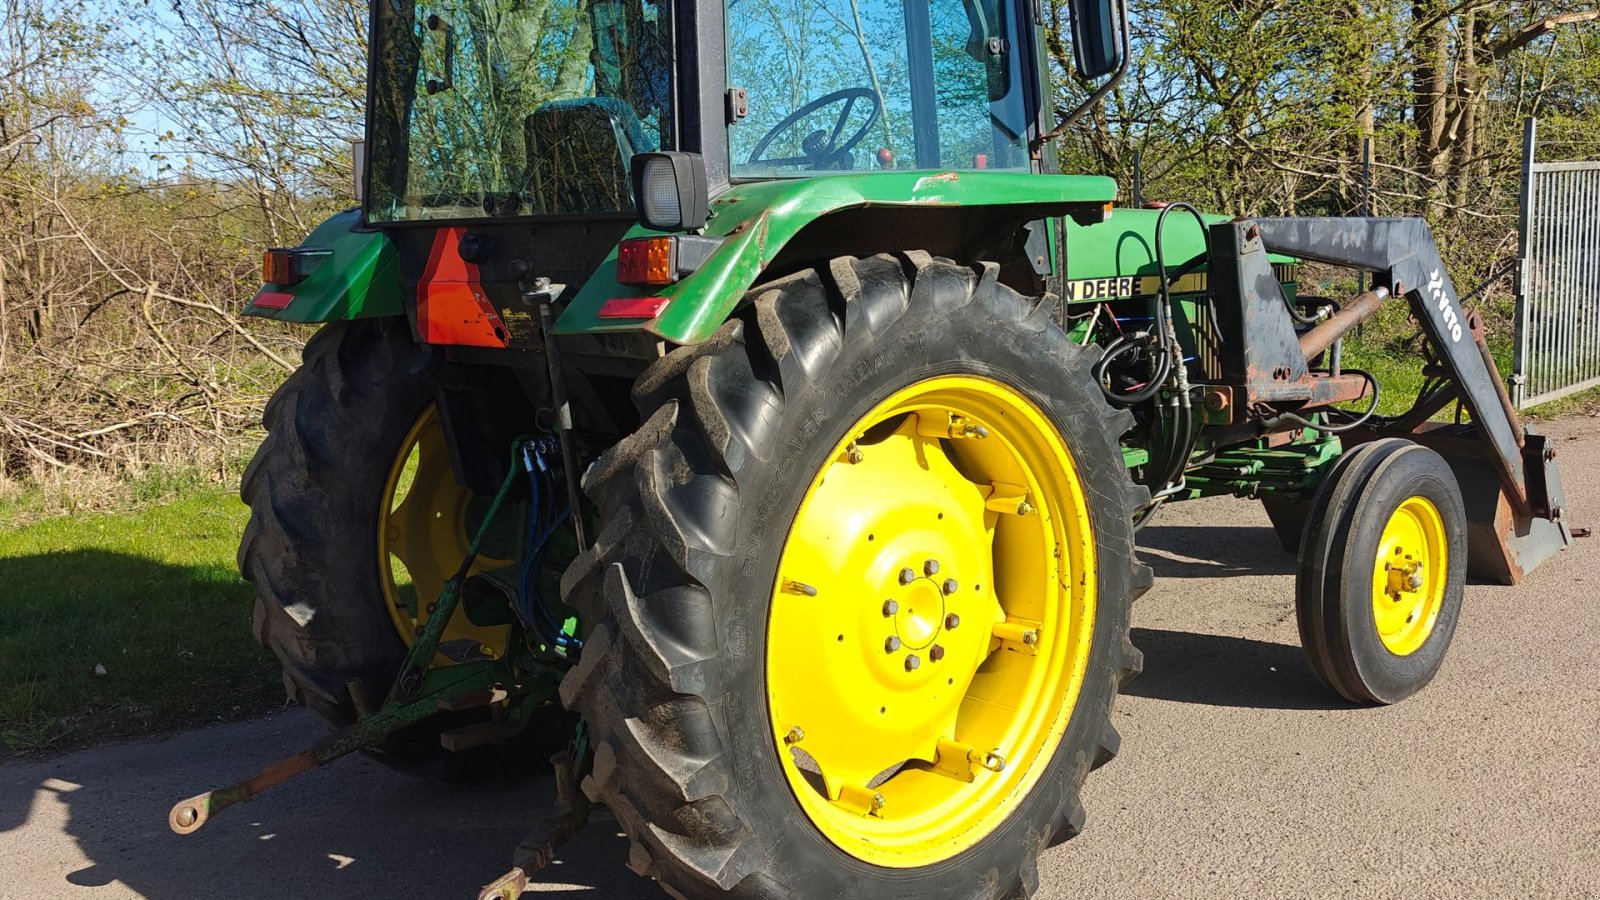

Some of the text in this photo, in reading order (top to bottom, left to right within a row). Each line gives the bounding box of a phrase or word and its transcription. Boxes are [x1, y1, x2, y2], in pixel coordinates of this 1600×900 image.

[1083, 277, 1142, 299] DEERE
[1439, 290, 1462, 343] VETO
[833, 349, 895, 402] RADIAL
